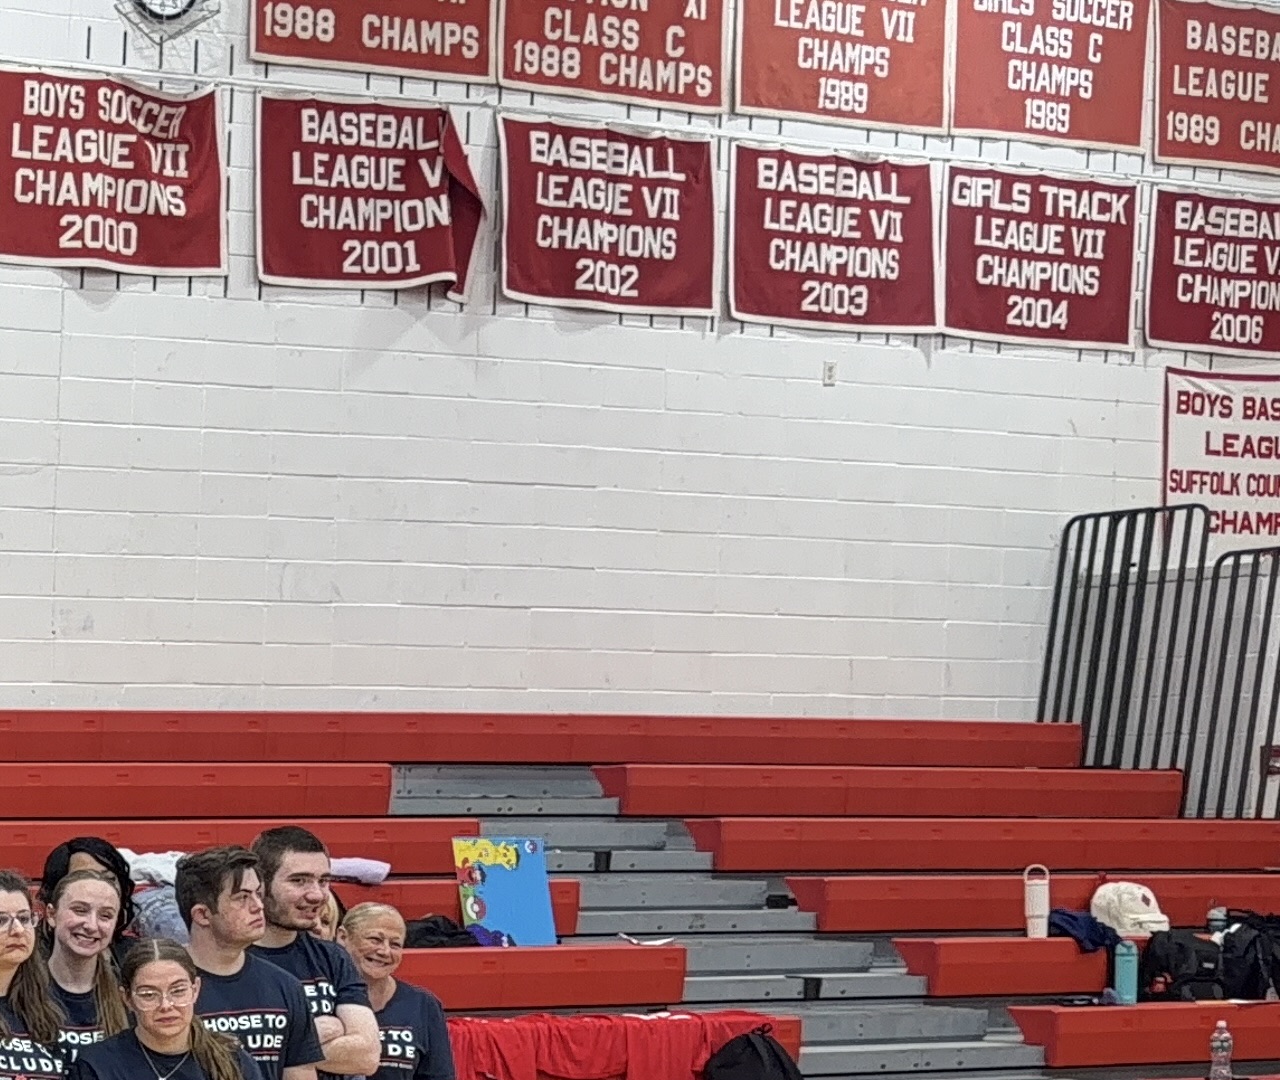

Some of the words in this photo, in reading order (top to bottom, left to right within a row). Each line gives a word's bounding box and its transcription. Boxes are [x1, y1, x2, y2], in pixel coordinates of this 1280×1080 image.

[264, 2, 335, 42] 1988
[362, 14, 478, 58] CHAMPS
[545, 7, 639, 51] CLASS
[666, 26, 685, 57] C
[775, 0, 865, 37] LEAGUE
[882, 8, 915, 42] VII
[1052, 0, 1133, 31] SOCCER
[798, 37, 890, 77] CHAMPS
[1002, 21, 1073, 58] CLASS
[1088, 33, 1102, 63] C
[514, 40, 580, 78] 1988
[600, 53, 712, 97] CHAMPS
[1008, 59, 1093, 99] CHAMPS
[1174, 65, 1269, 103] LEAGUE
[24, 80, 85, 119] BOYS
[98, 87, 186, 138] SOCCER
[818, 77, 868, 113] 1989
[1025, 98, 1070, 133] 1989
[1167, 111, 1219, 145] 1989
[12, 123, 137, 168] LEAGUE
[145, 141, 188, 178] VII
[530, 131, 686, 181] BASEBALL
[293, 152, 405, 191] LEAGUE
[758, 158, 910, 204] BASEBALL
[15, 168, 186, 216] CHAMPIONS
[642, 187, 679, 220] VII
[1039, 185, 1129, 224] TRACK
[59, 215, 137, 255] 2000
[869, 209, 903, 242] VII
[975, 215, 1064, 255] LEAGUE
[1071, 227, 1105, 259] VII
[343, 240, 420, 273] 2001
[770, 238, 899, 279] CHAMPIONS
[976, 254, 1100, 295] CHAMPIONS
[576, 259, 638, 296] 2002
[802, 281, 868, 315] 2003
[1007, 295, 1067, 329] 2004
[1210, 312, 1263, 343] 2006
[1177, 391, 1233, 418] BOYS
[1169, 469, 1240, 496] SUFFOLK
[265, 1015, 287, 1029] TO
[388, 1030, 412, 1042] TO
